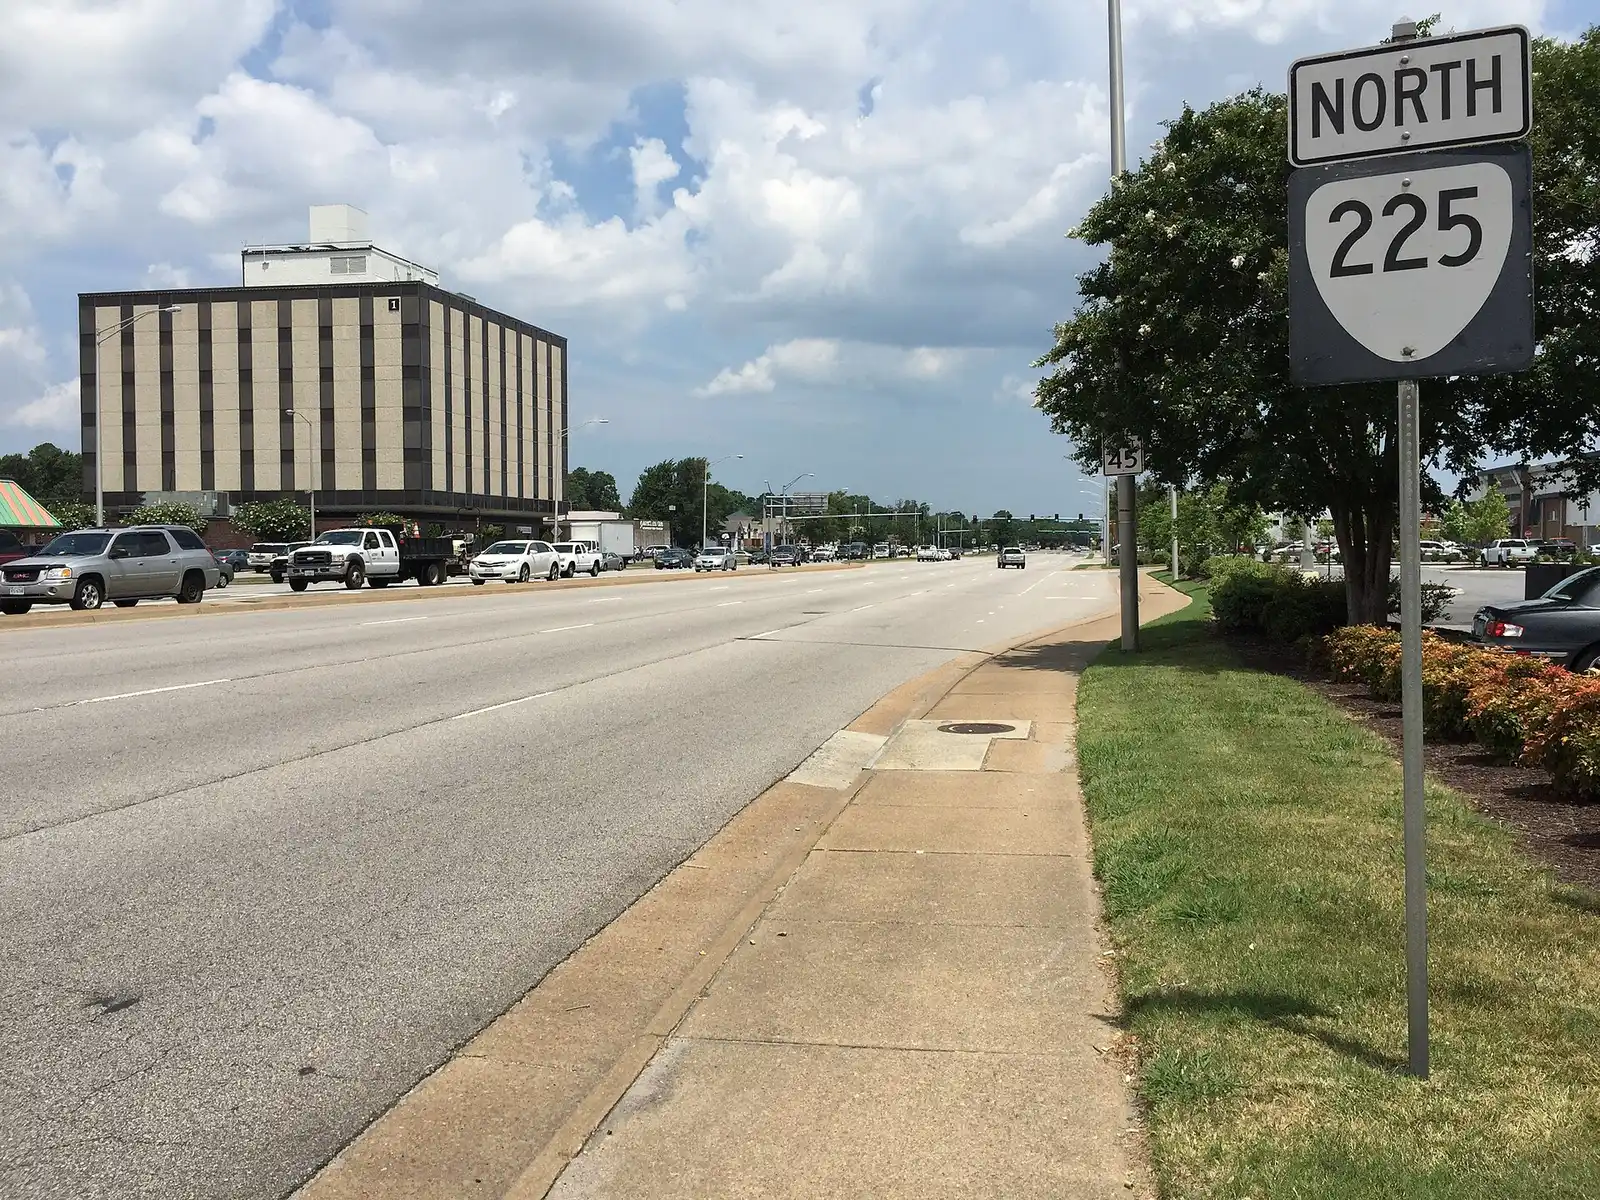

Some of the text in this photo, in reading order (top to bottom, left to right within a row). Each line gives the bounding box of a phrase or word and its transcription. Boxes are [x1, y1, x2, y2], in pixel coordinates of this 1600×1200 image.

[1311, 54, 1502, 138] NORTH
[1328, 186, 1483, 278] 225
[1107, 448, 1138, 469] 45
